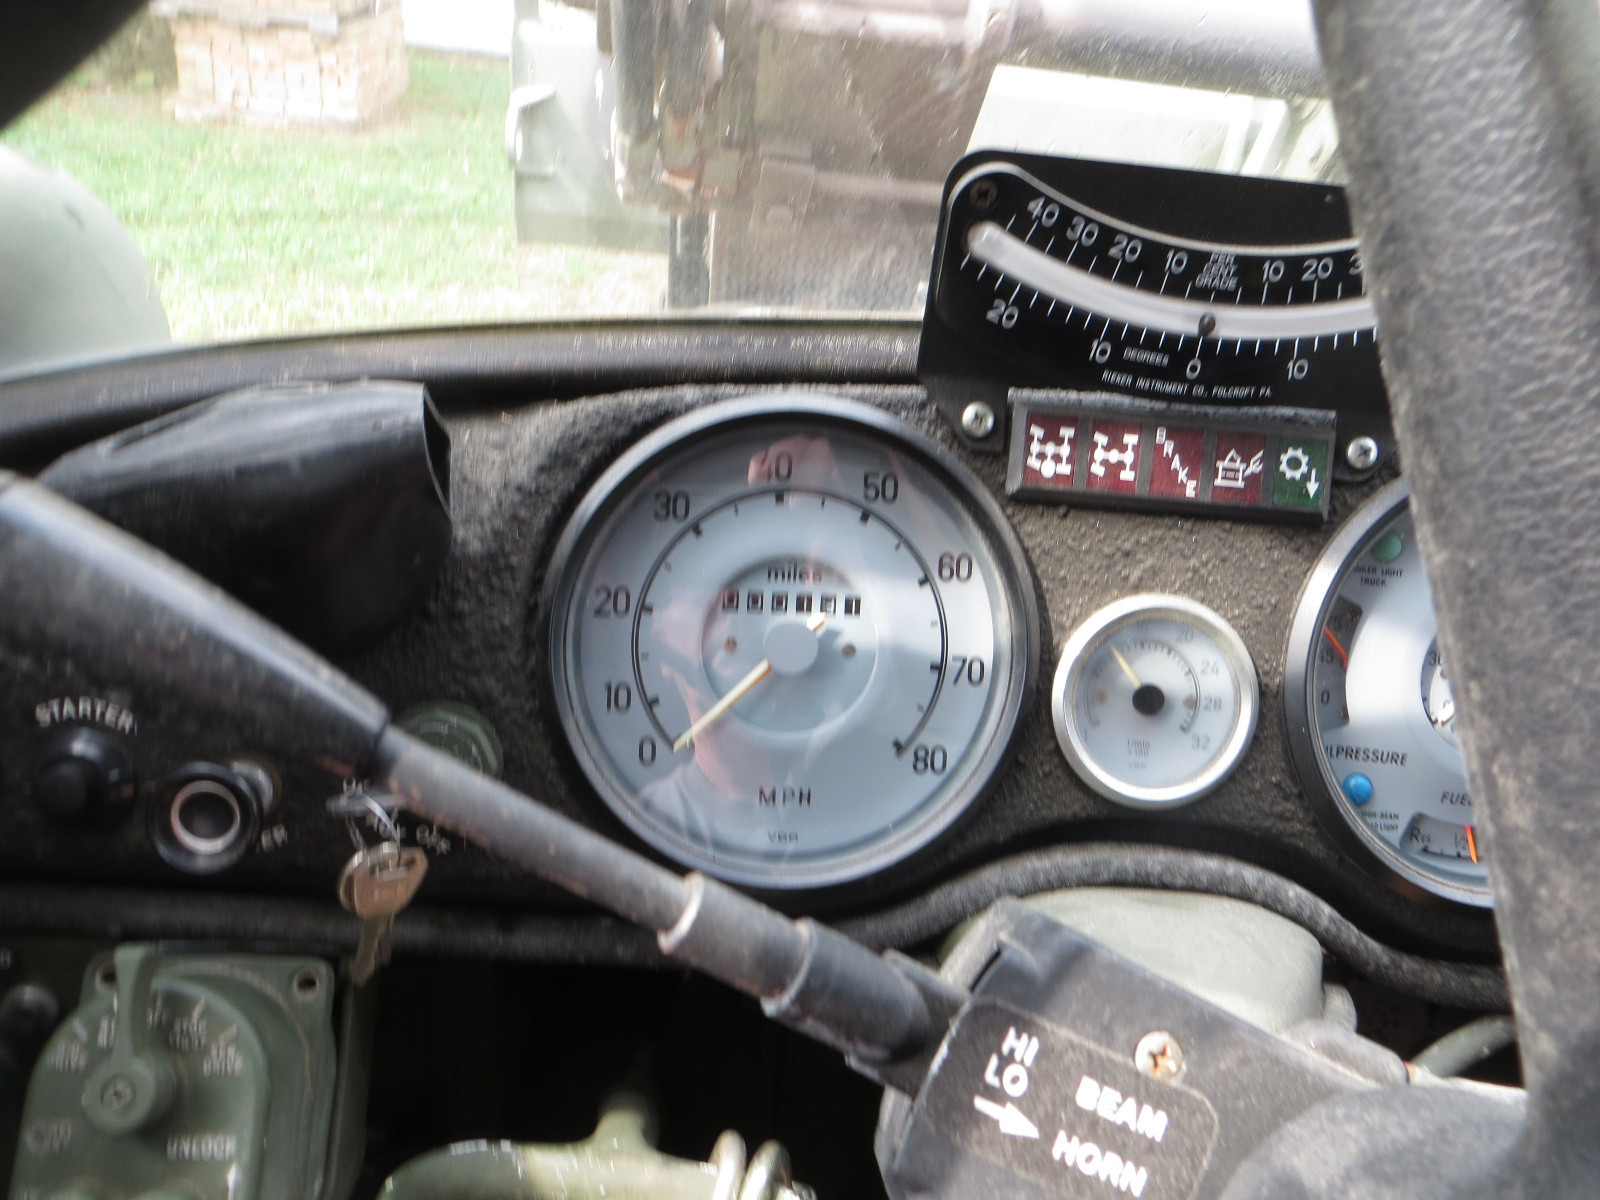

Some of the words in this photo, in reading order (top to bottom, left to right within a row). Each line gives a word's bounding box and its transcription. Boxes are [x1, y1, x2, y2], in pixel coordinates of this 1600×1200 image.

[1027, 197, 1060, 228] 40
[1067, 216, 1099, 247] 30
[1108, 234, 1143, 263] 20
[1164, 250, 1188, 274] 10
[1262, 259, 1285, 283] 10
[1301, 257, 1333, 282] 20
[1349, 252, 1363, 276] 3
[986, 299, 1018, 328] 20
[1088, 339, 1111, 364] 10
[1123, 346, 1170, 368] DEGREES
[1186, 358, 1201, 380] 0
[1287, 358, 1308, 380] 10
[1136, 376, 1190, 396] INSTRUMENT
[1212, 385, 1256, 399] FOLCROFT
[763, 451, 793, 482] 40
[863, 472, 898, 504] 50
[1156, 427, 1197, 498] BRAKE
[654, 490, 690, 522] 30
[938, 552, 973, 582] 60
[767, 561, 822, 585] miles
[1356, 564, 1377, 575] NKER
[1360, 576, 1386, 588] TRUCK
[594, 585, 631, 617] 20
[951, 656, 985, 687] 70
[1200, 659, 1219, 676] 24
[605, 682, 632, 714] 10
[1320, 689, 1330, 706] 0
[36, 696, 134, 735] STARTER
[638, 738, 657, 766] 0
[912, 745, 947, 775] 80
[759, 785, 812, 807] MPH
[1001, 1026, 1040, 1067] HI
[985, 1053, 1028, 1098] LO
[1075, 1075, 1168, 1143] BEAM
[1052, 1129, 1147, 1198] HORN
